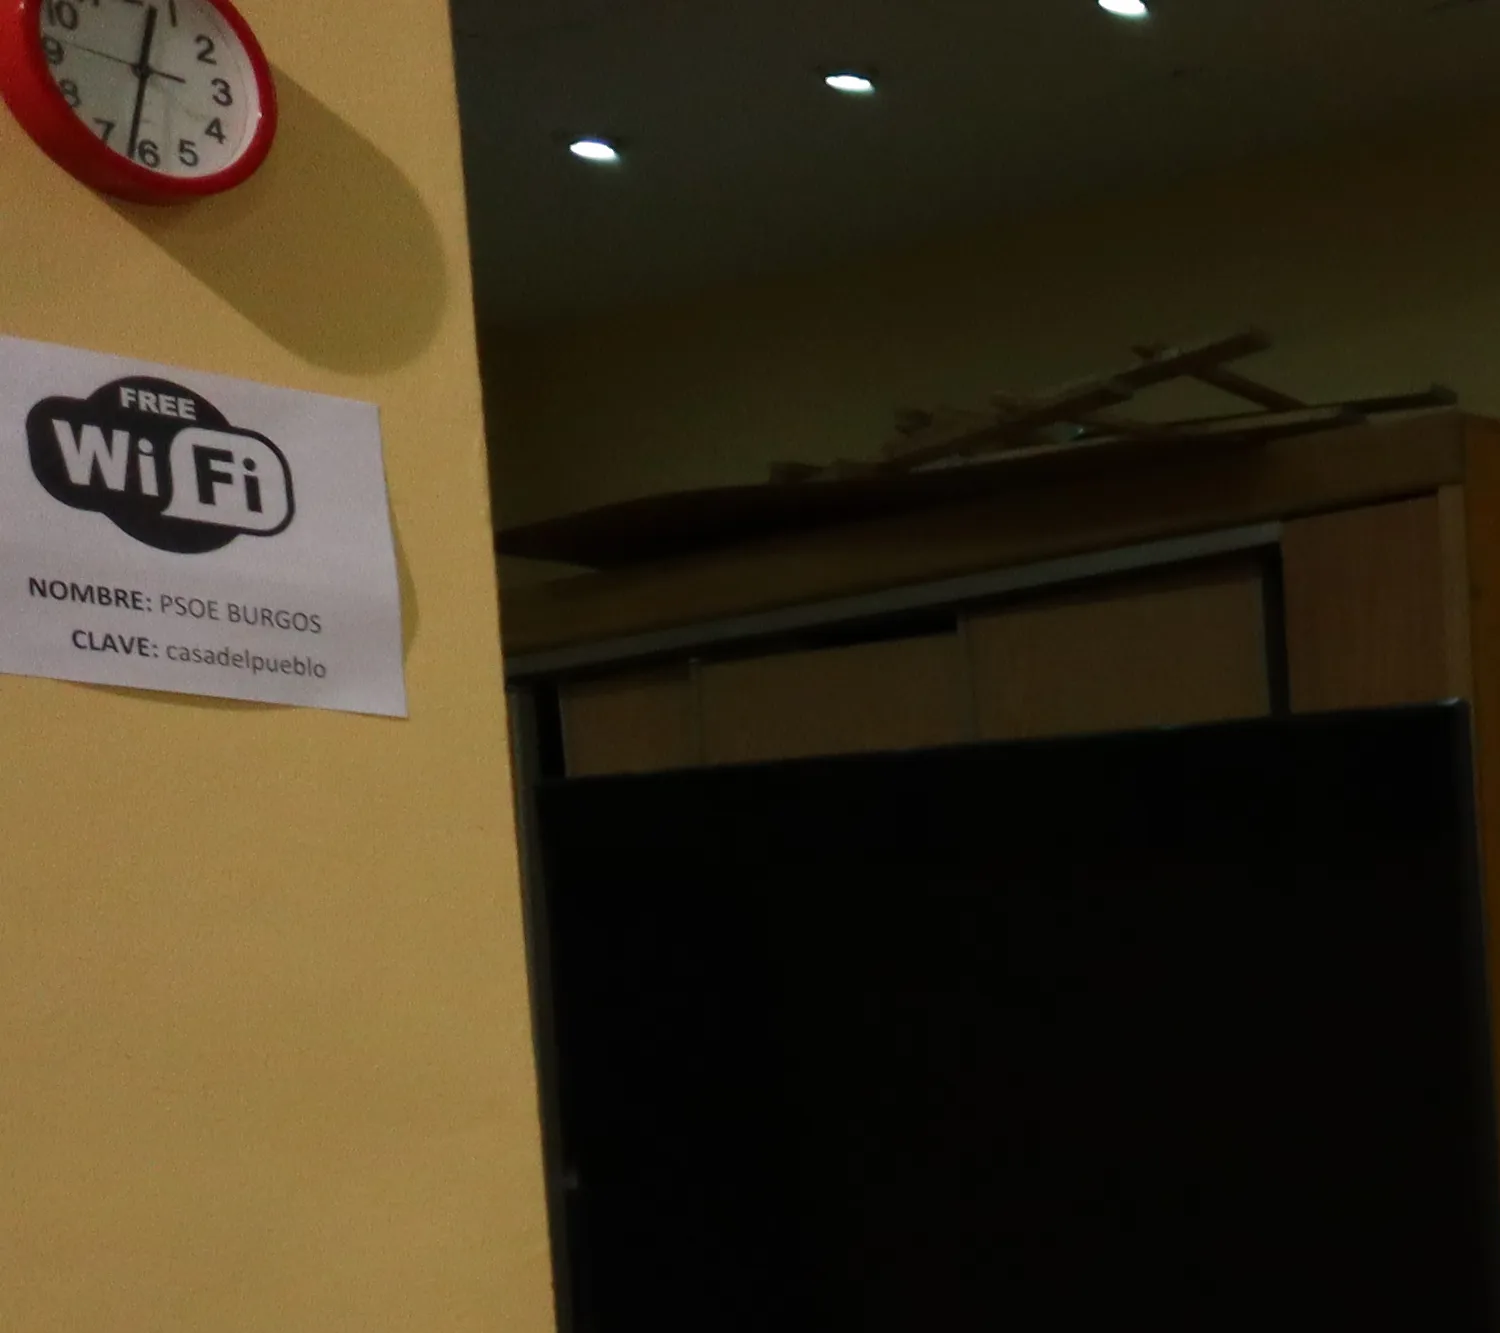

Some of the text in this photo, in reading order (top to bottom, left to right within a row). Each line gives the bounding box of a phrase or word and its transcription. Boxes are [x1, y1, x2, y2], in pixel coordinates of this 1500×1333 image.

[195, 35, 217, 65] 2
[211, 78, 232, 106] 3
[93, 118, 115, 142] 7
[205, 118, 225, 144] 4
[138, 140, 160, 168] 6
[179, 139, 198, 166] 5
[120, 387, 196, 420] FREE
[28, 576, 322, 634] NOMBRE: PSOE BURGOS
[71, 629, 327, 679] CLAVE: casadelpueblo
